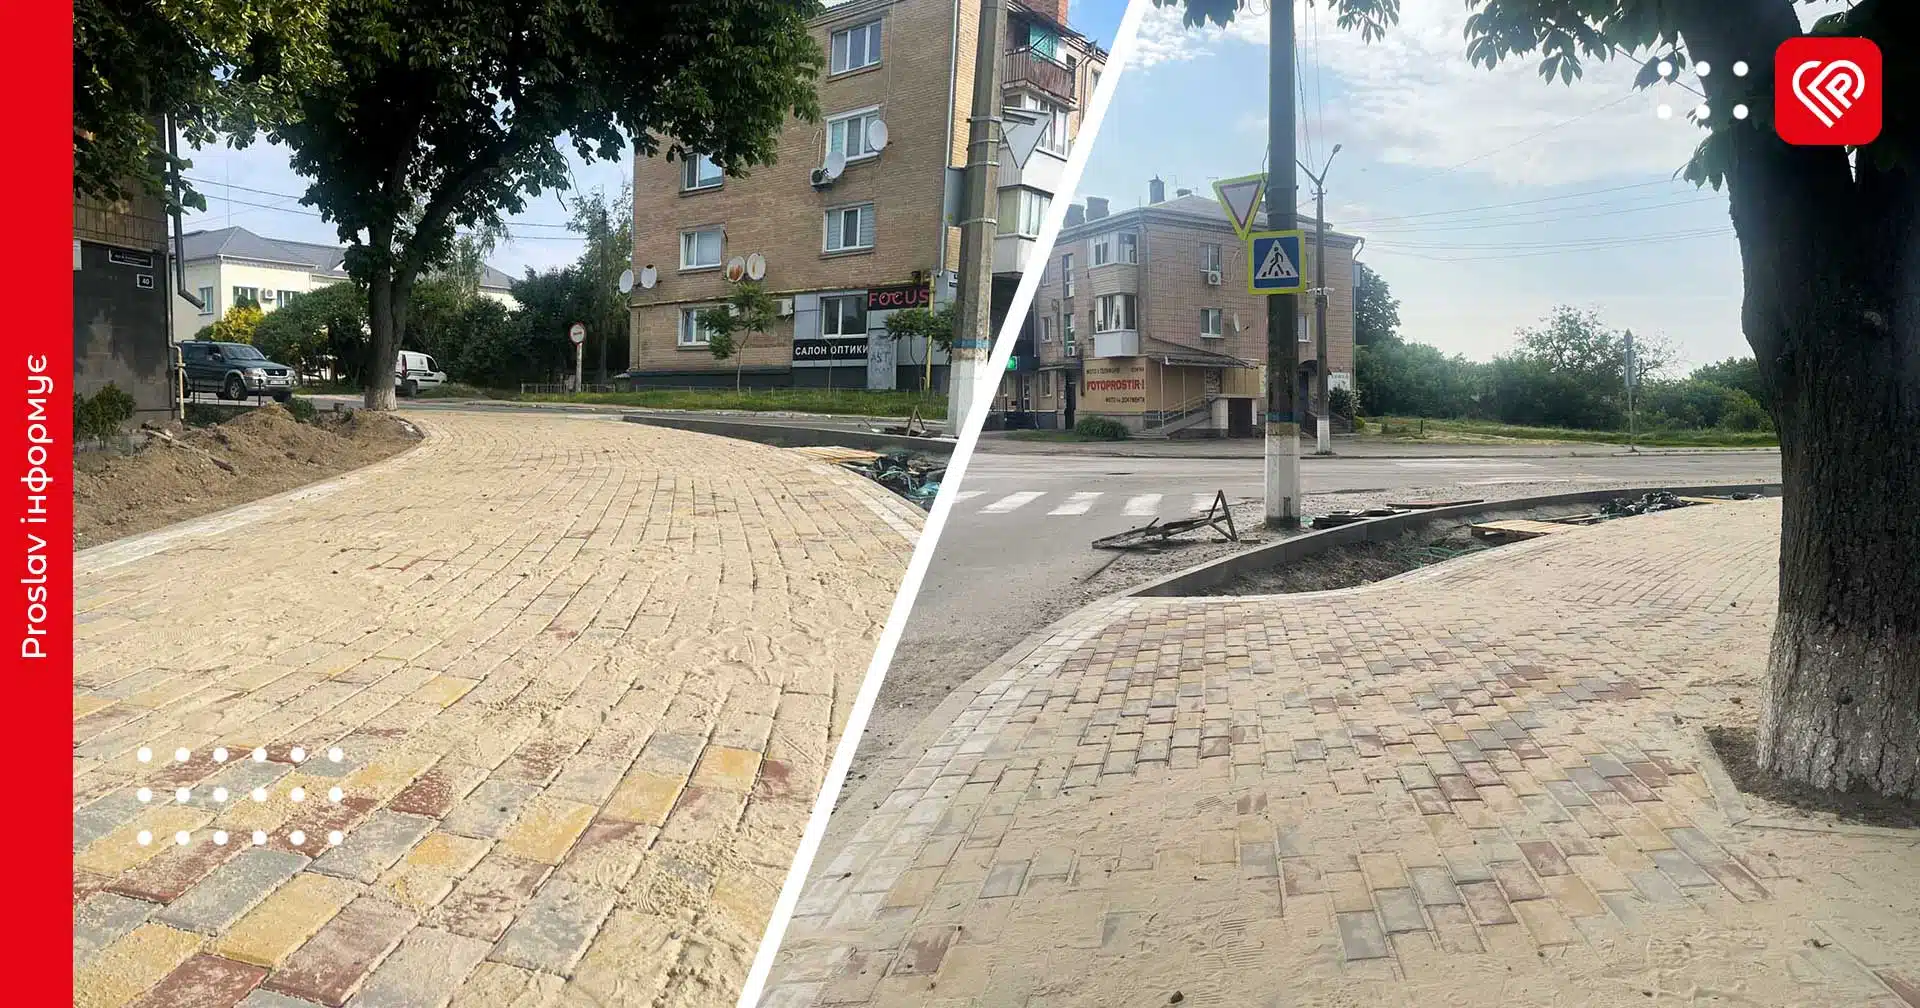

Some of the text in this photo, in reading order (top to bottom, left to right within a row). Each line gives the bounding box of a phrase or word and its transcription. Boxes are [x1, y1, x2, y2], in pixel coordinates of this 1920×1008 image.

[869, 288, 930, 307] FOCUS
[795, 345, 869, 355] САЛОН ОПТИКИ
